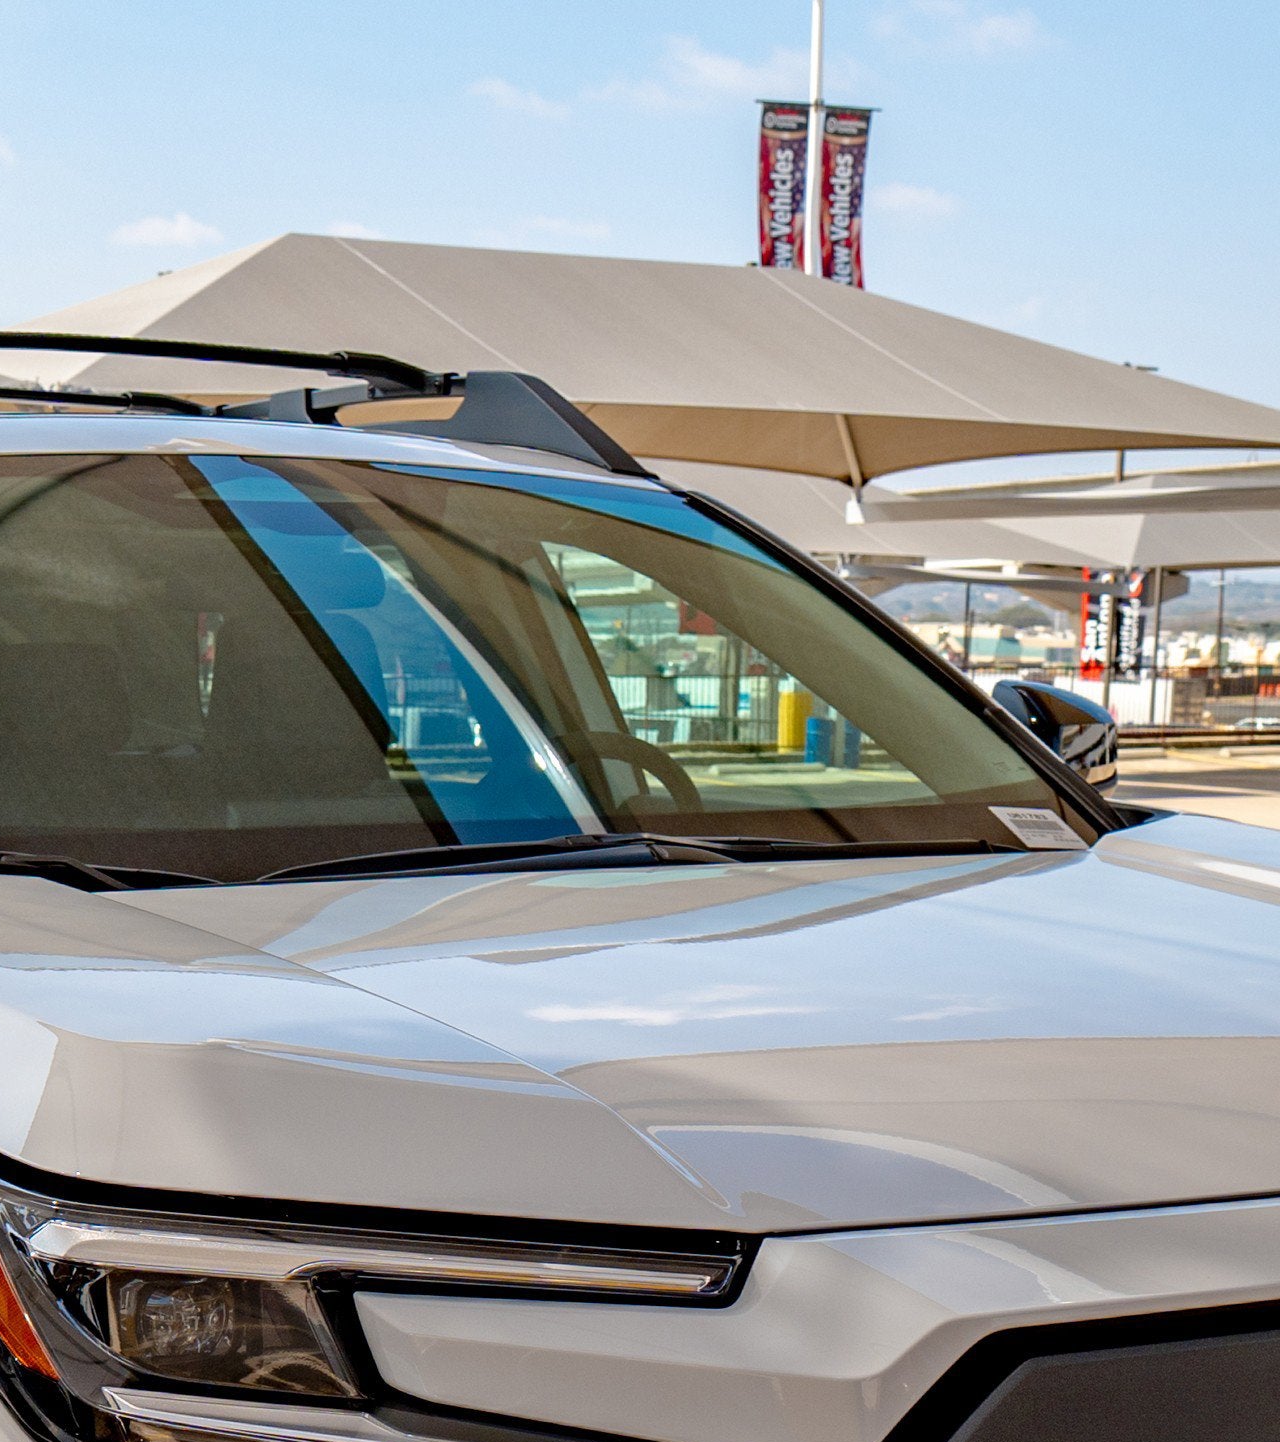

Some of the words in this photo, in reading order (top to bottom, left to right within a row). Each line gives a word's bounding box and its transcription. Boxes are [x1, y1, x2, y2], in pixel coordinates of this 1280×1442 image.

[768, 148, 795, 238] Vehicles
[829, 153, 854, 242] Vehicles
[775, 241, 793, 269] ew
